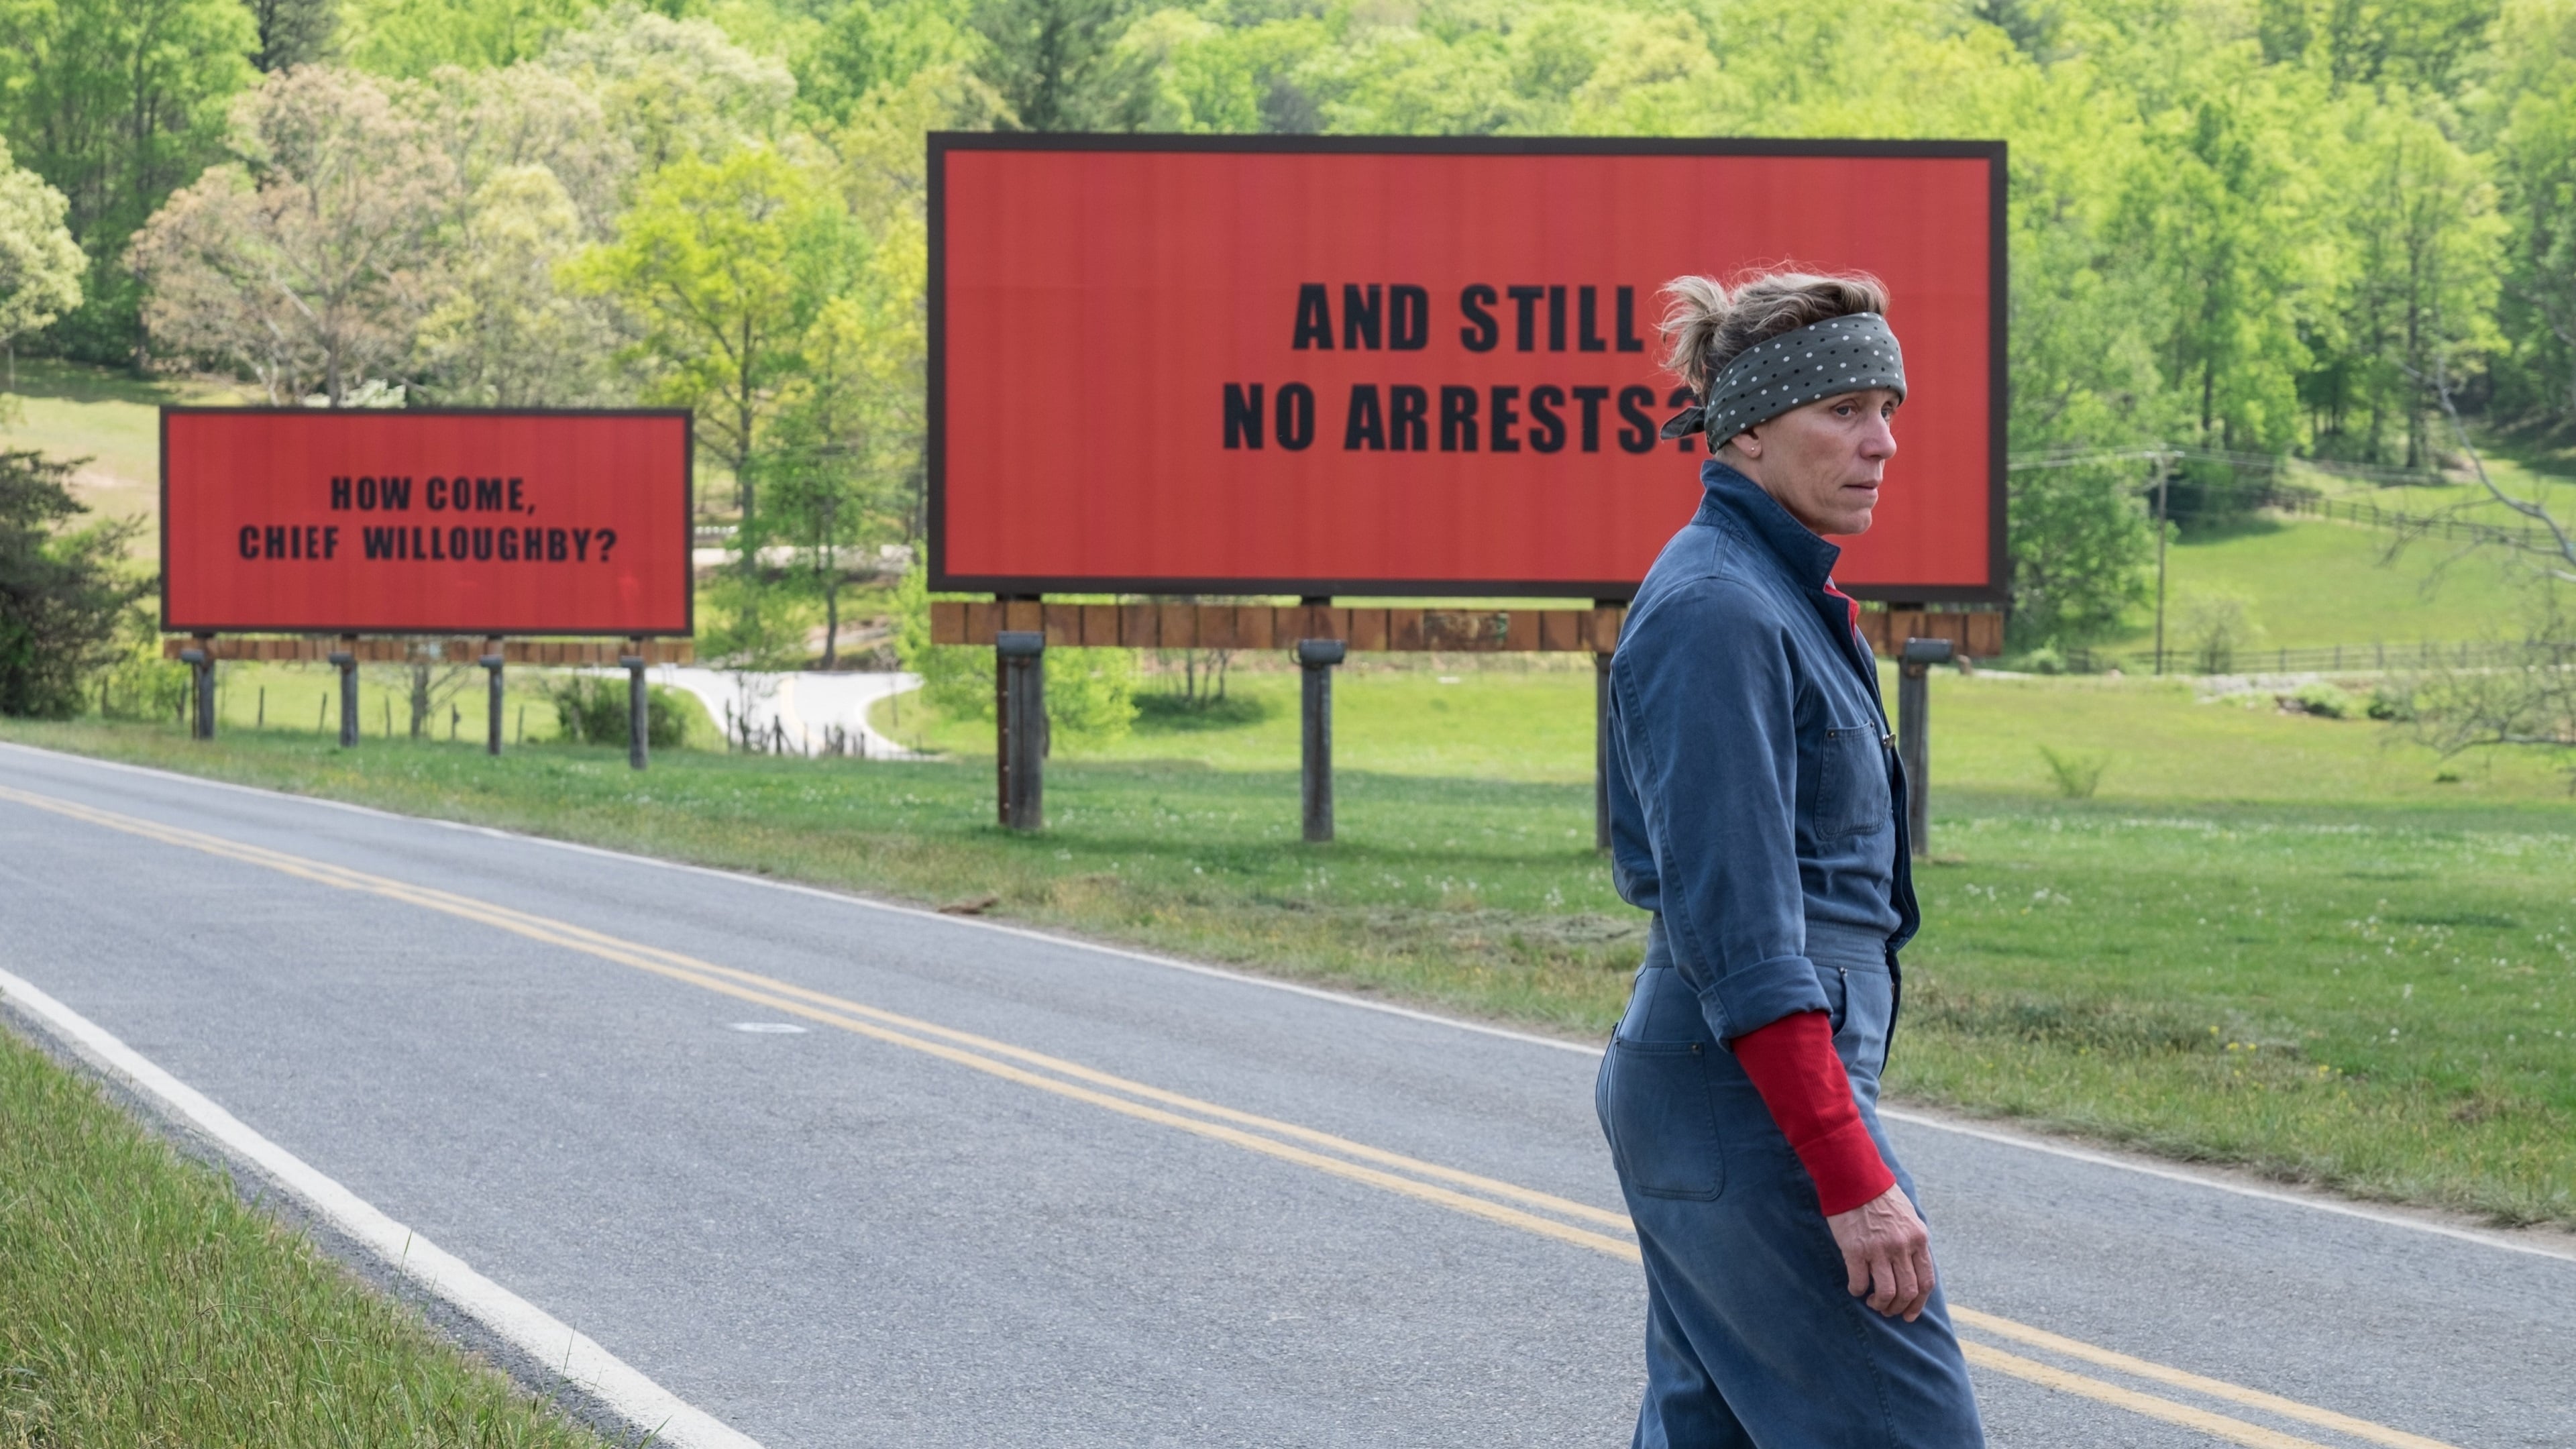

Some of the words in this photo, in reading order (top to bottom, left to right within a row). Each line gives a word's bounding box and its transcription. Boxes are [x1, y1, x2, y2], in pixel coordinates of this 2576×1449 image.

[1292, 283, 1429, 352] AND
[1460, 284, 1644, 354] STILL
[1223, 382, 1315, 452] NO
[331, 476, 411, 512] HOW
[426, 477, 535, 517] COME,
[238, 525, 339, 561] CHIEF
[363, 527, 617, 561] WILLOUGHBY?
